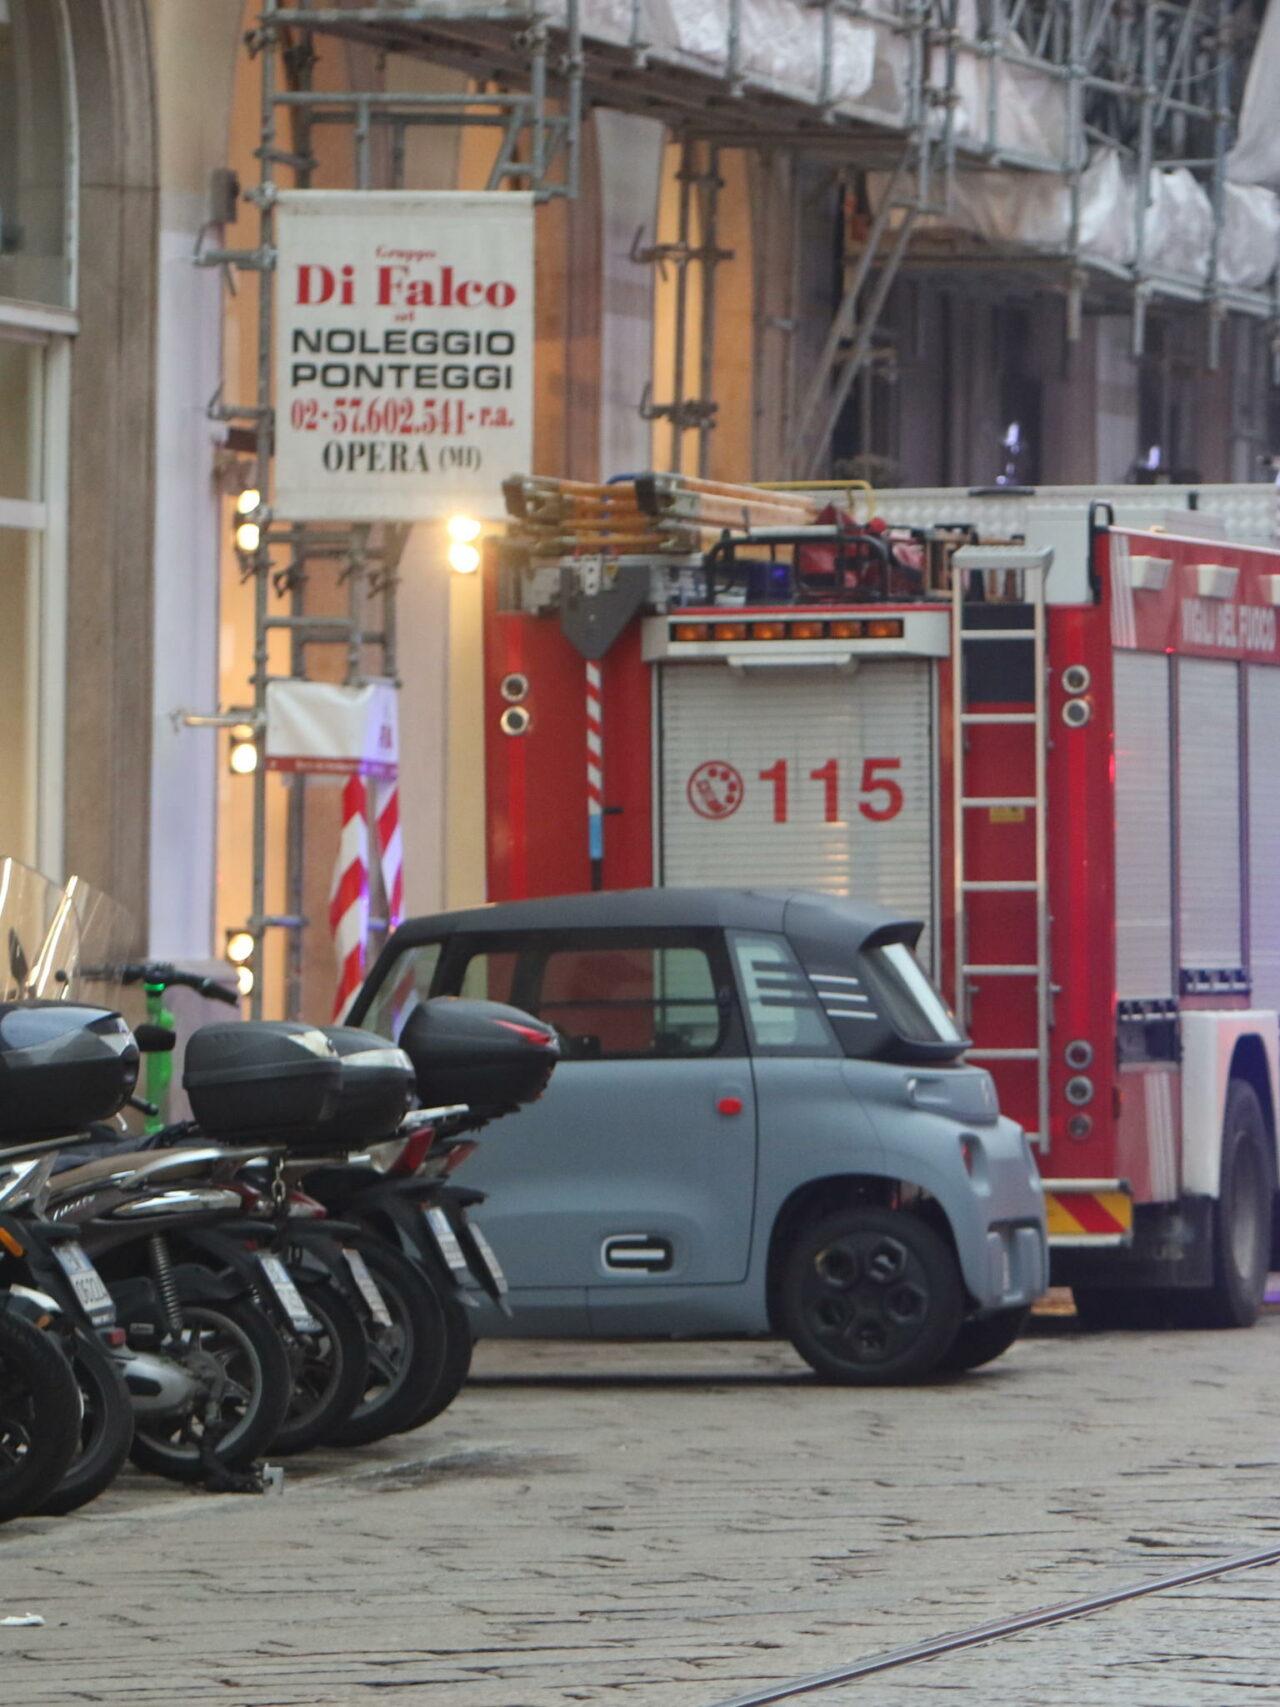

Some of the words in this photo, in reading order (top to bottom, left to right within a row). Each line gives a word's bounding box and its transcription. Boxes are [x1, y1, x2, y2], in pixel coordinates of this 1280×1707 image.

[295, 264, 355, 305] Di
[376, 265, 517, 308] Falco
[292, 328, 516, 356] NOLEGGIO
[291, 362, 513, 390] PONTEGGI
[322, 439, 429, 472] OPERA
[758, 757, 905, 824] 115
